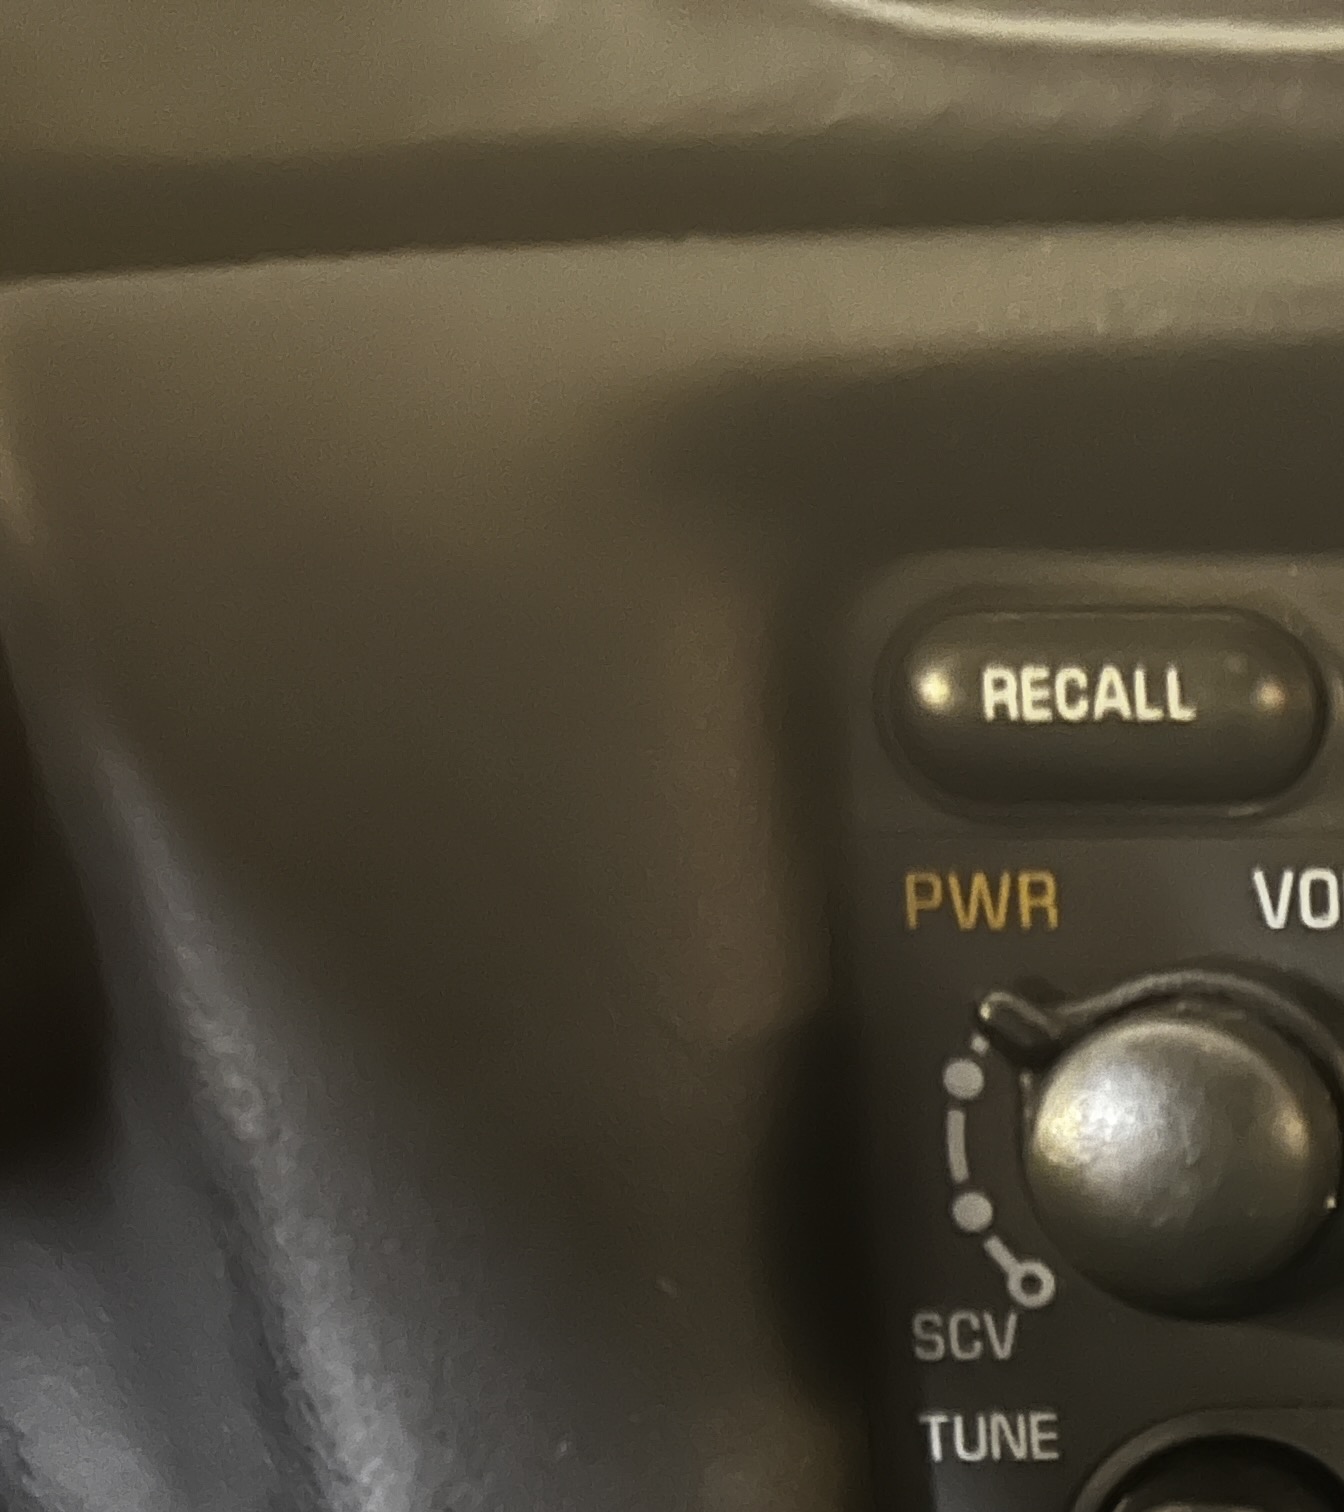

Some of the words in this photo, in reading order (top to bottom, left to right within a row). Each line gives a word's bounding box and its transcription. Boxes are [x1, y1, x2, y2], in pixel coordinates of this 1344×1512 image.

[982, 665, 1197, 723] RECALL
[904, 870, 1059, 930] PWR
[912, 1310, 1020, 1361] SCV
[920, 1412, 1059, 1463] TUNE
